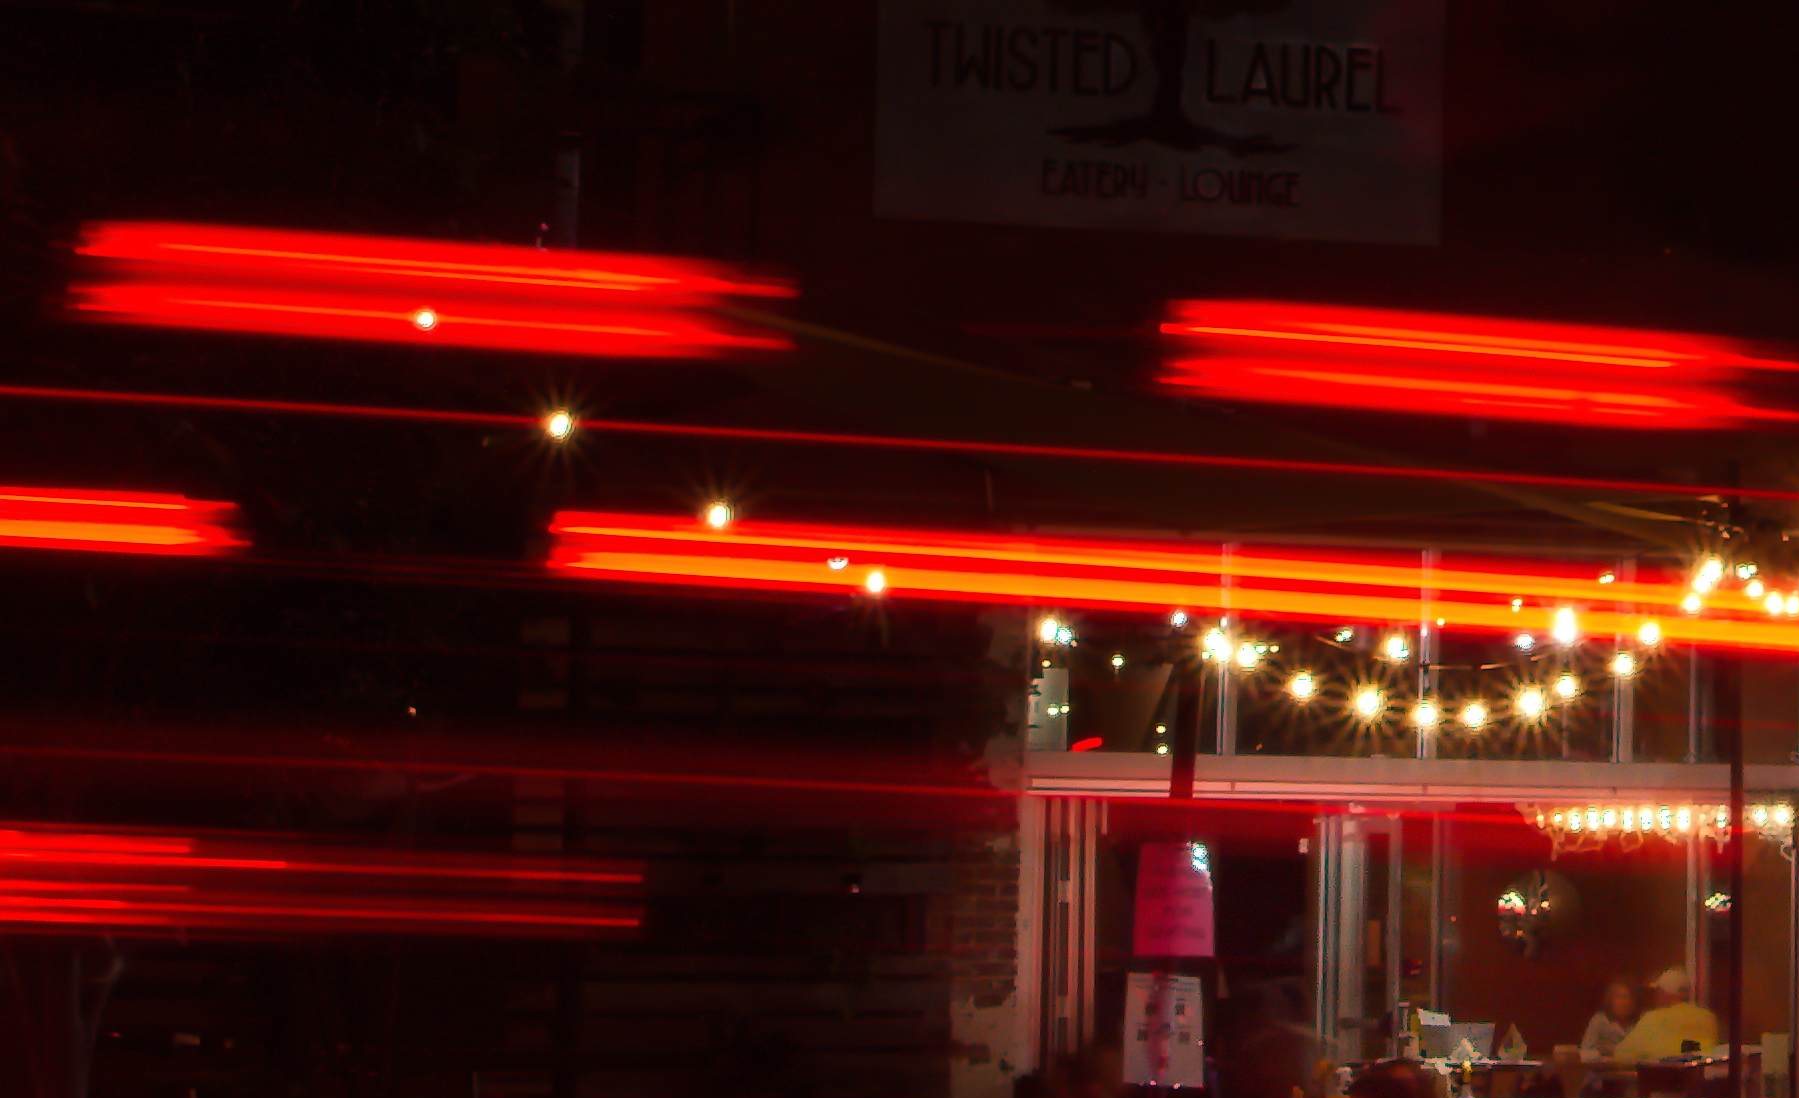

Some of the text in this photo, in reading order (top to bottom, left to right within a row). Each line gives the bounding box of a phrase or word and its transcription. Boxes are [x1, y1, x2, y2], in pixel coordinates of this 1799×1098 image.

[925, 18, 1403, 115] TWISTED LAUREL
[1040, 157, 1301, 208] EATERY LOUNGE
